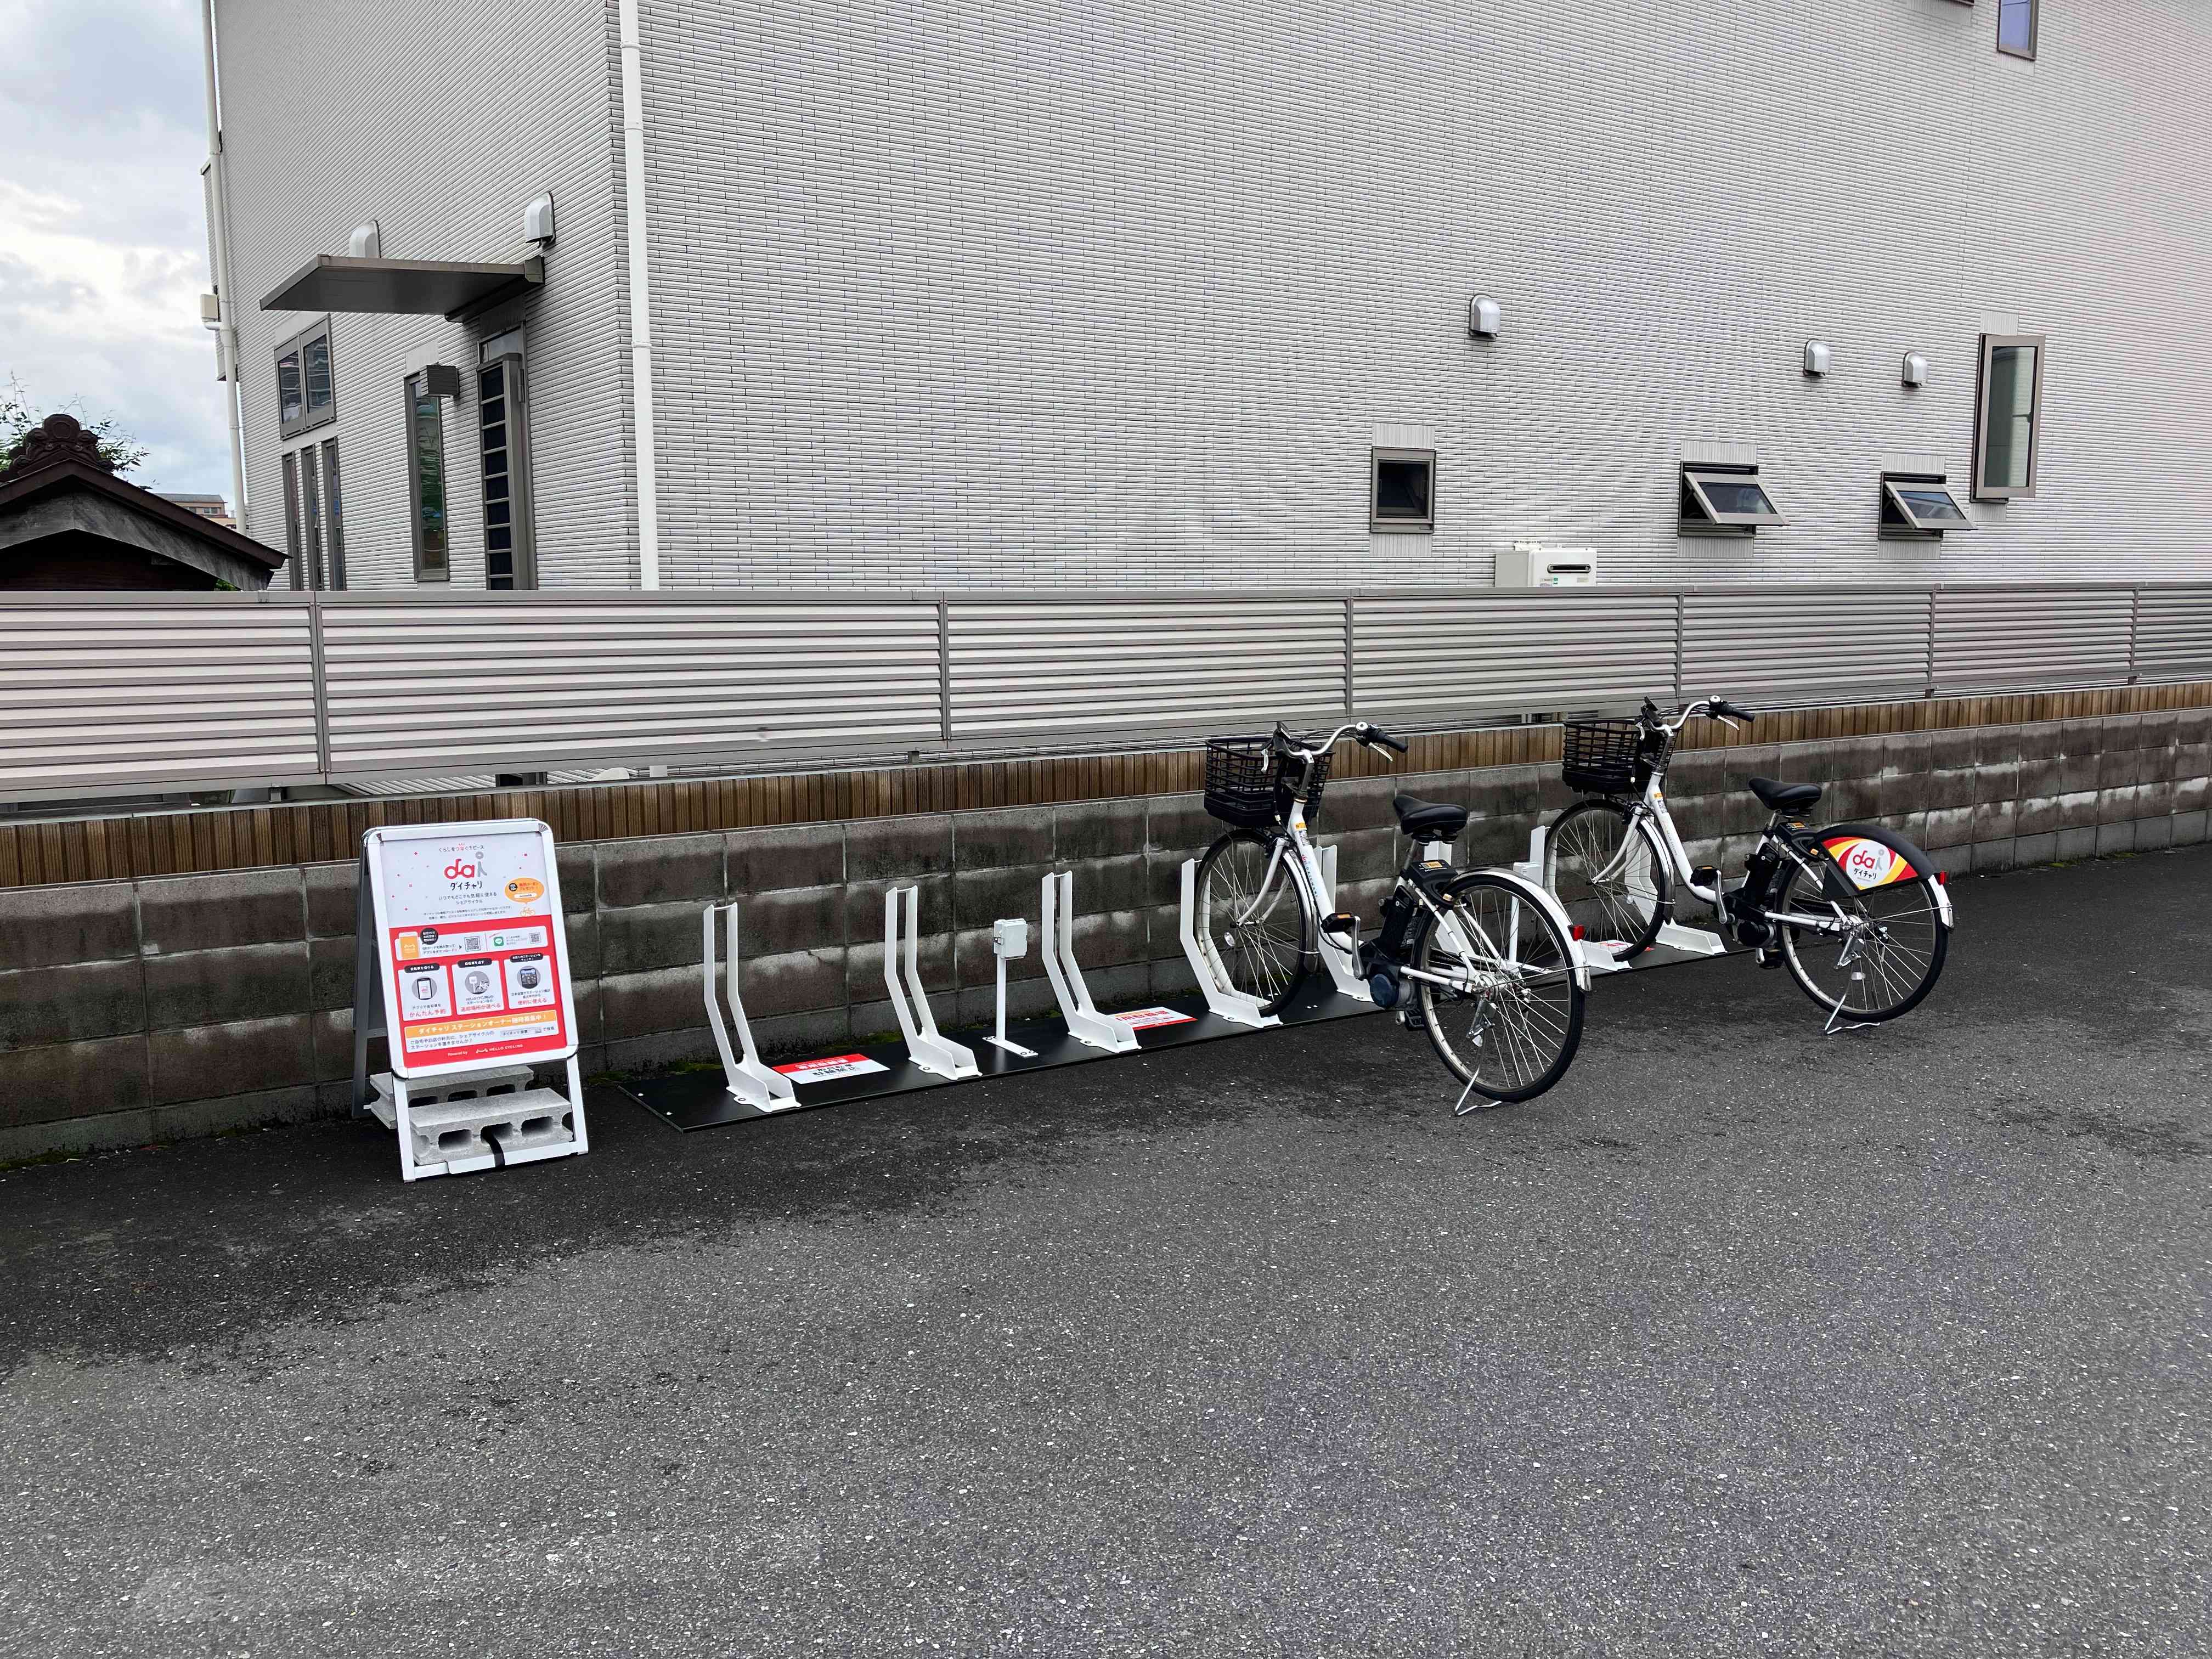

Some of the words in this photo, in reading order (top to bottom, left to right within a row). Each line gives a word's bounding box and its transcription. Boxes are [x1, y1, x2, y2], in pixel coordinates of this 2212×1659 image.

[444, 851, 488, 879] dai
[1854, 868, 1877, 879] ダイチャリ
[450, 881, 482, 890] ダイチャリ
[409, 1009, 446, 1018] かんたん予約
[418, 1025, 449, 1035] ダイチャリ
